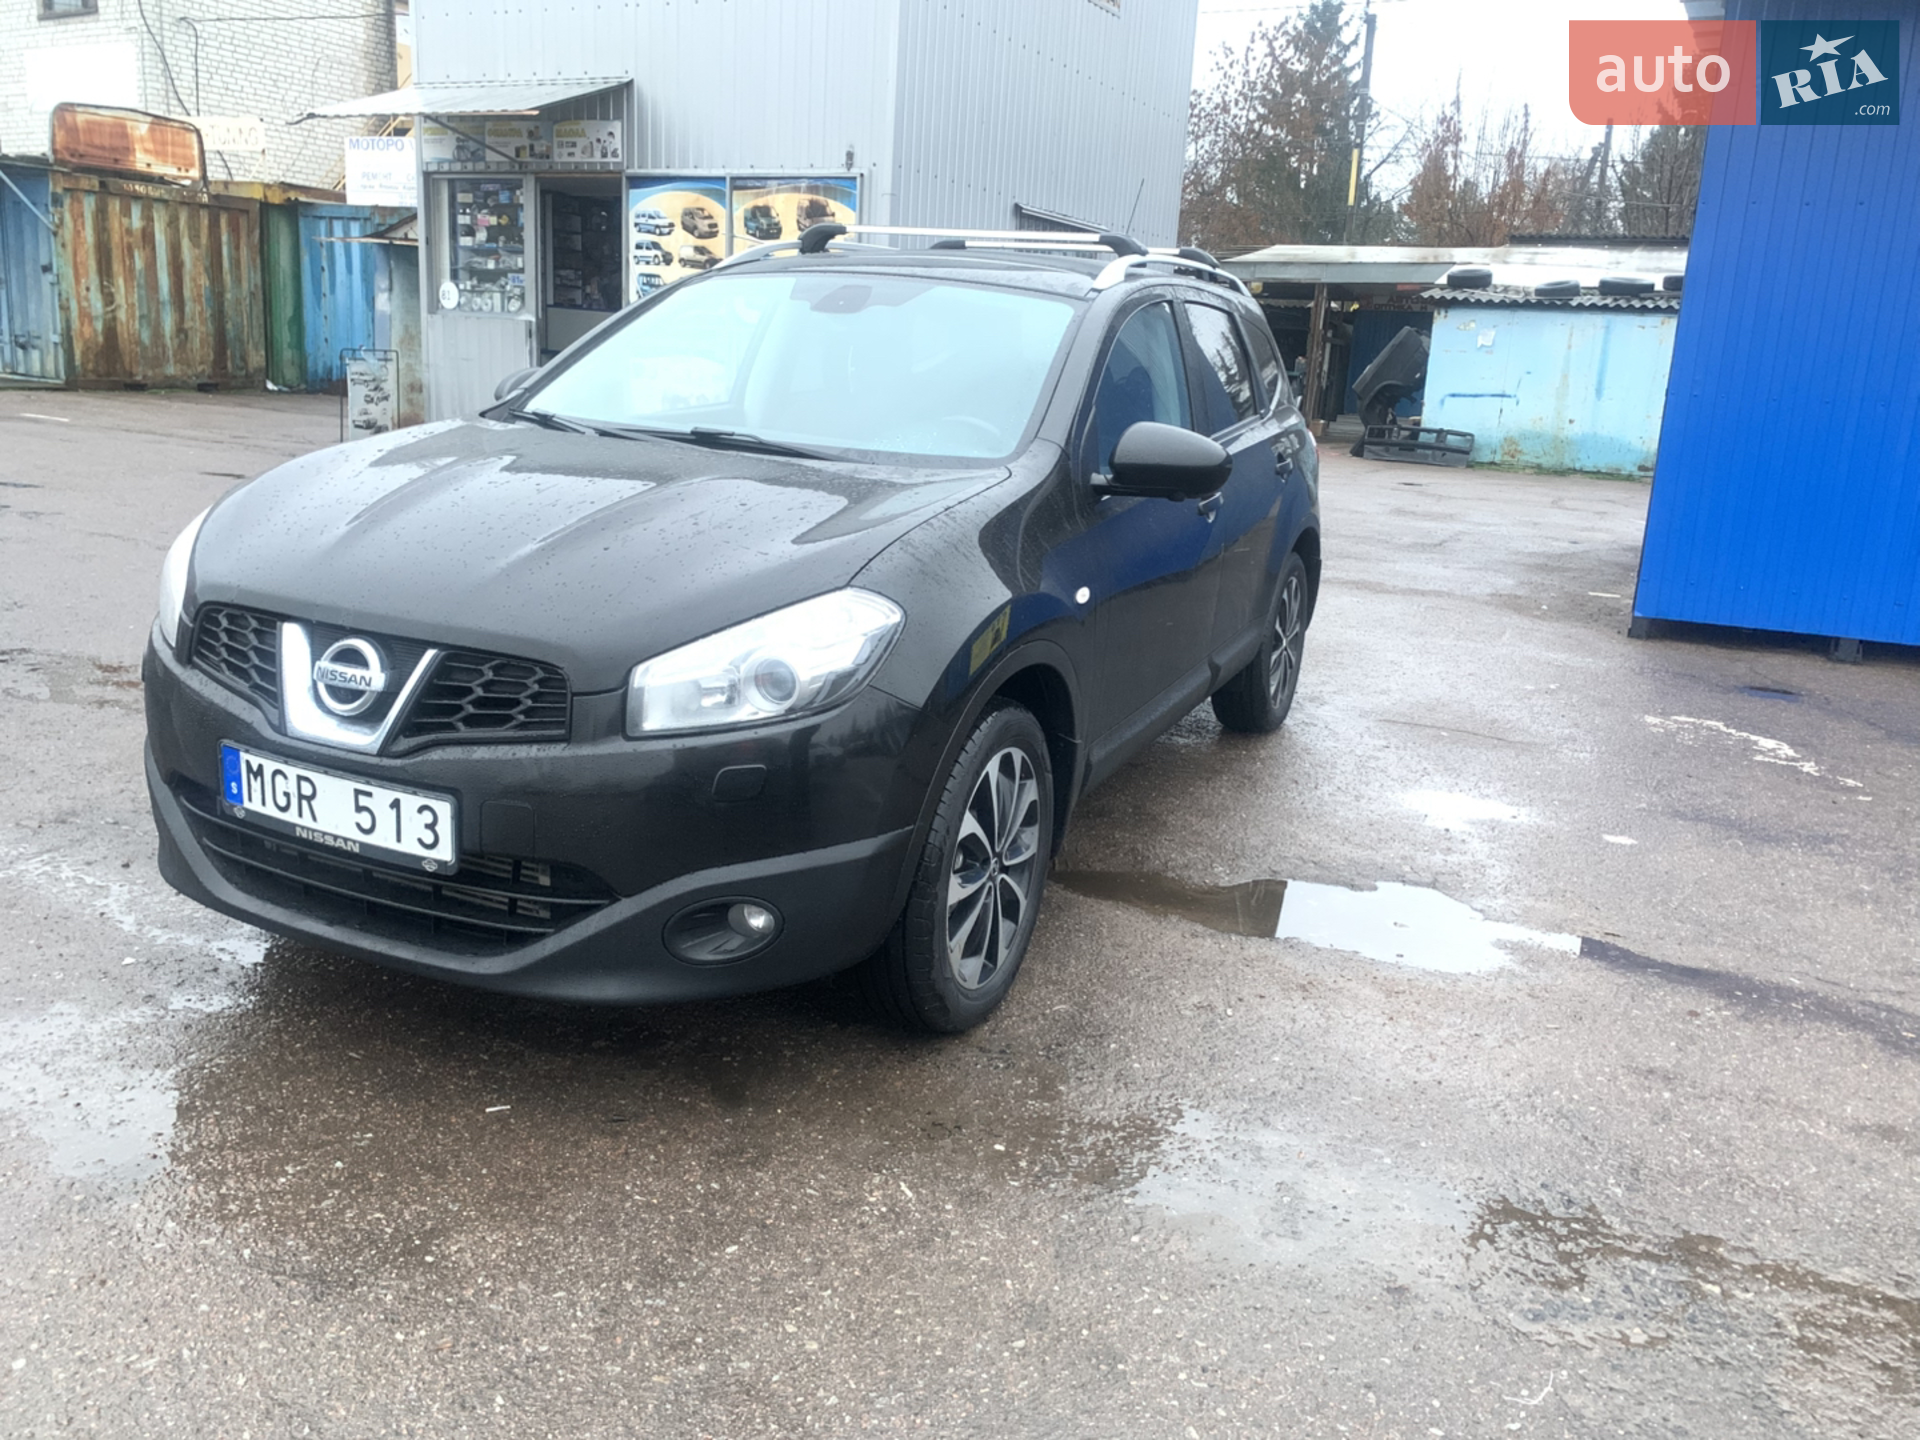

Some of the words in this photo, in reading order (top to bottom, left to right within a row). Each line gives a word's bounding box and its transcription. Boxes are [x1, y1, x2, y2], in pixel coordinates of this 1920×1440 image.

[317, 665, 373, 688] NISSAN
[230, 781, 239, 795] S
[245, 758, 318, 823] MGR
[353, 787, 440, 851] 513
[295, 825, 360, 853] NISSAN
